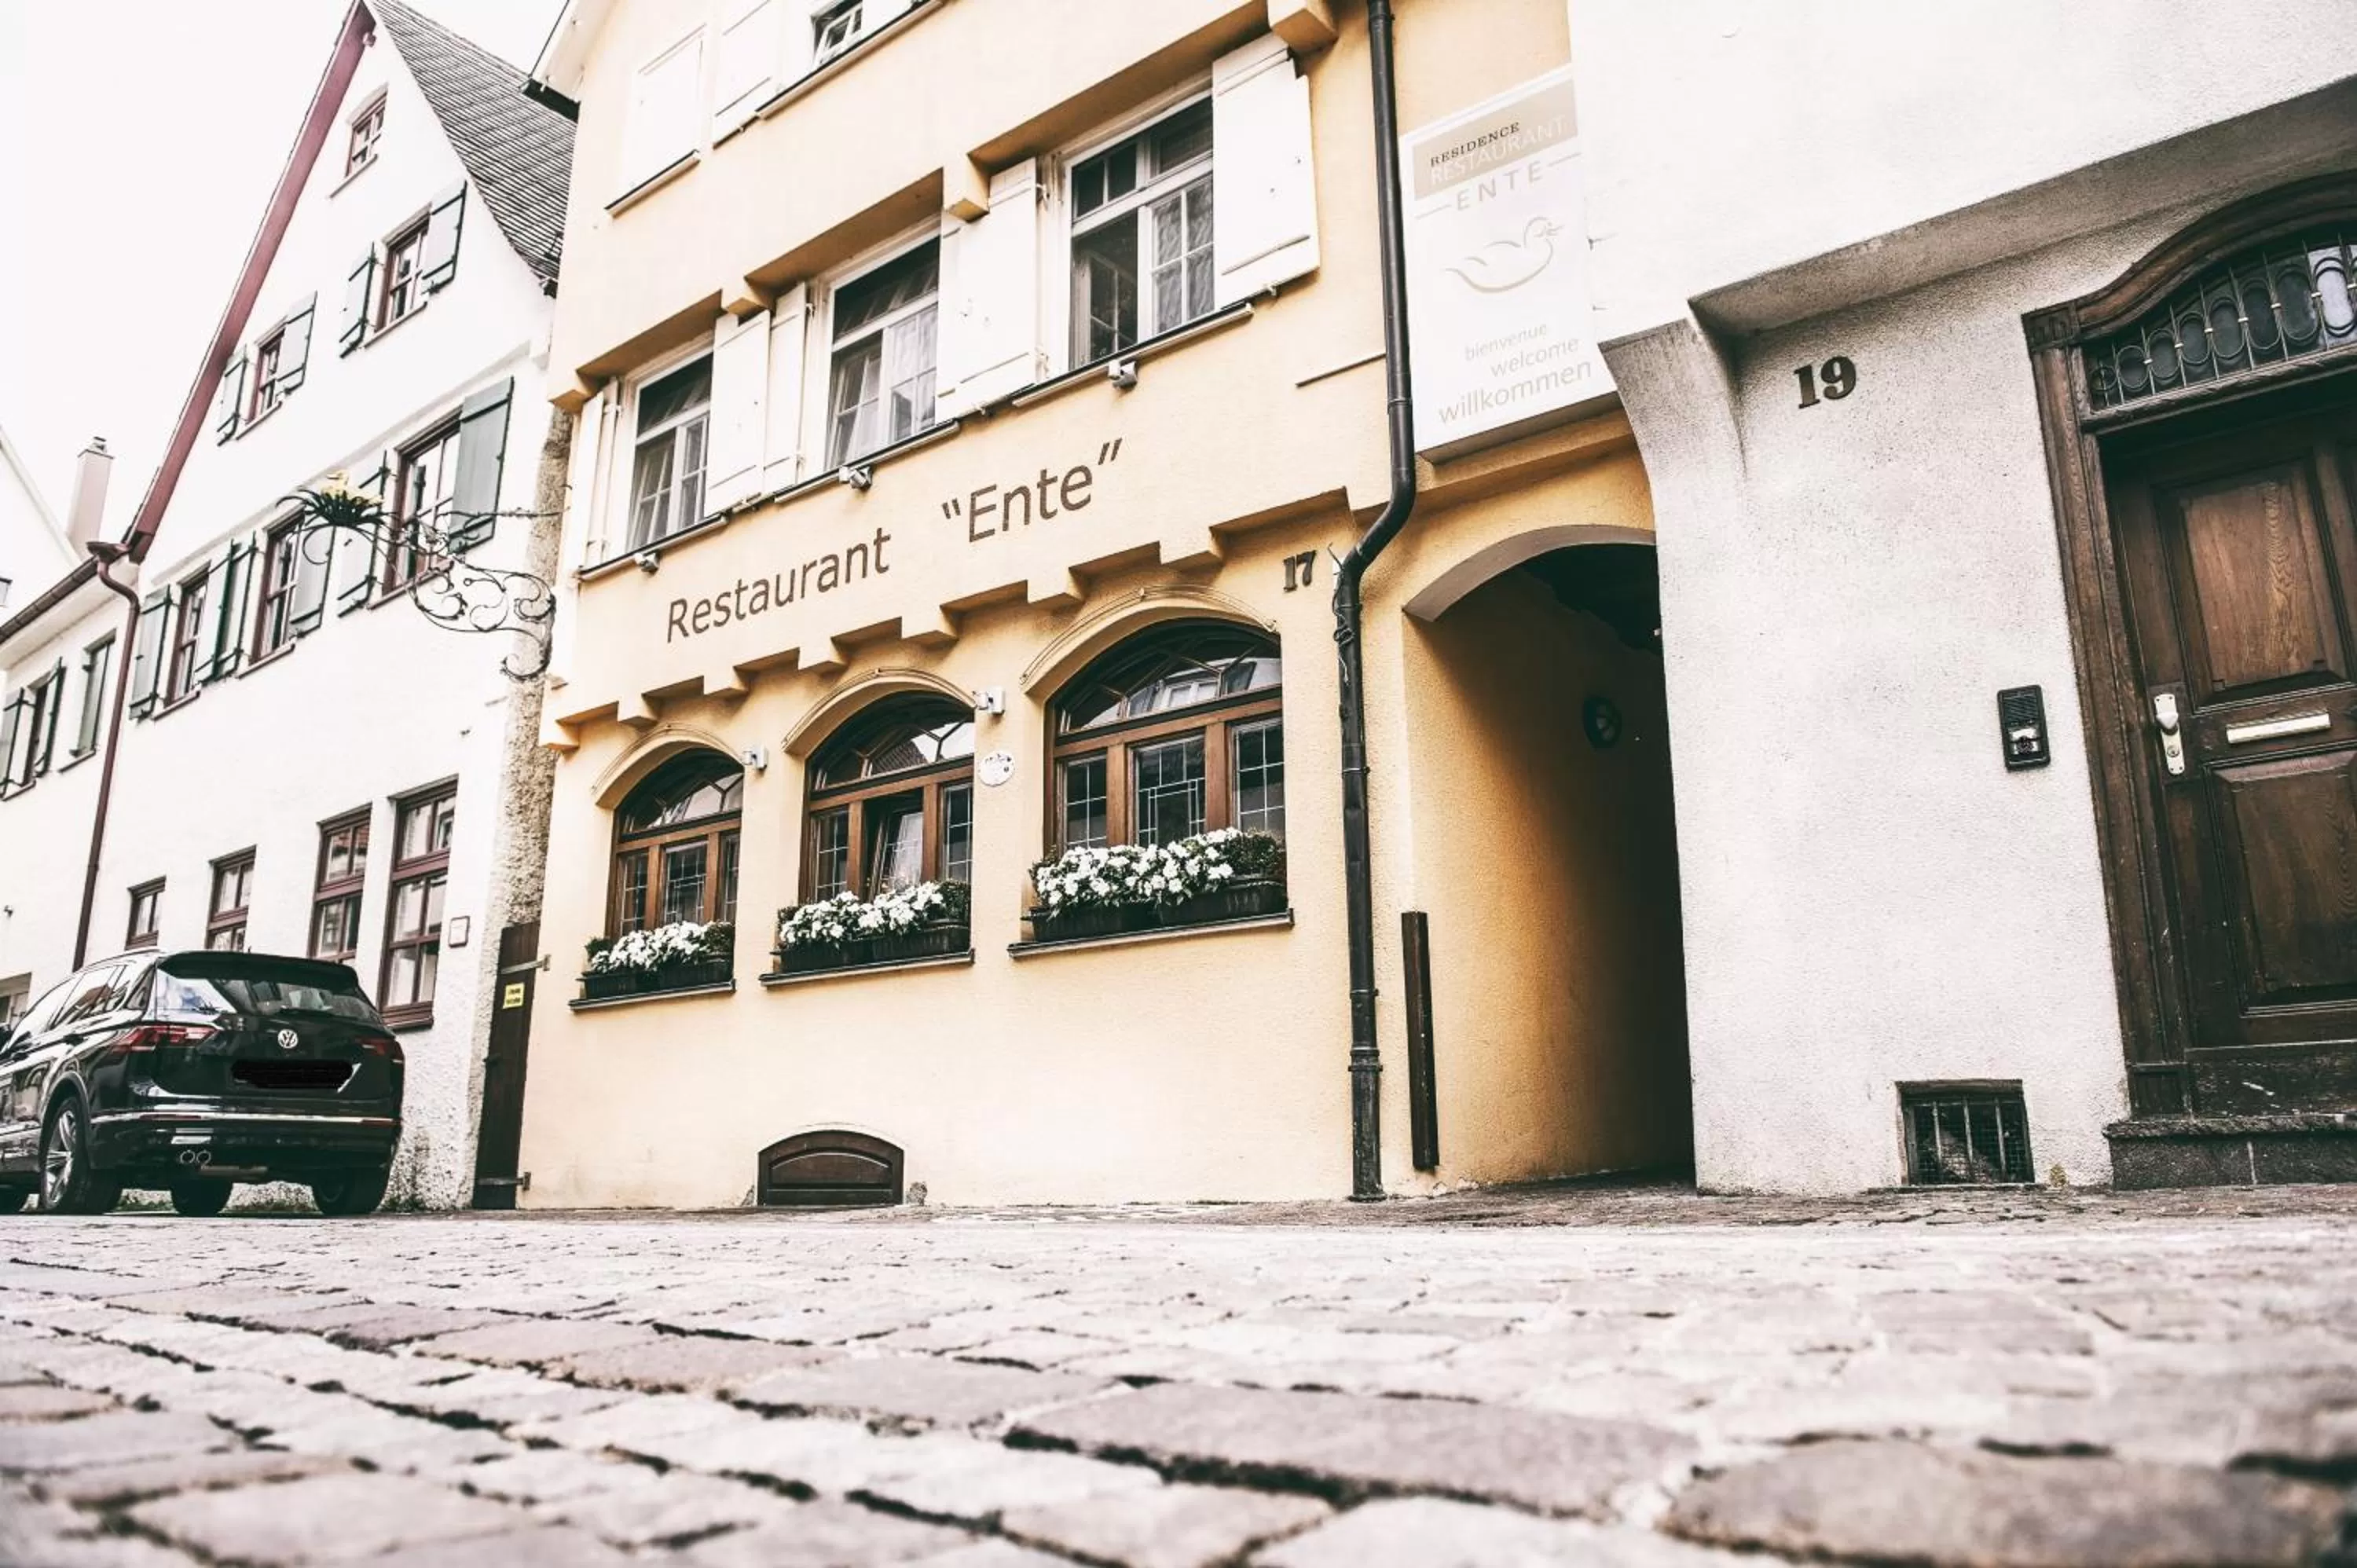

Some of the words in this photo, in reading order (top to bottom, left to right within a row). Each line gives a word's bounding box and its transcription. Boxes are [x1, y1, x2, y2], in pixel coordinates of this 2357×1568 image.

[1429, 116, 1566, 186] RESTAURANT
[1430, 122, 1520, 167] RESIDENCE
[1456, 160, 1545, 211] ENTE
[1464, 323, 1548, 361] bienvenue
[1490, 338, 1580, 377] welcome
[1438, 361, 1593, 425] willkommen
[1794, 356, 1857, 408] 19
[666, 527, 892, 643] Restaurant
[1283, 550, 1317, 593] 17
